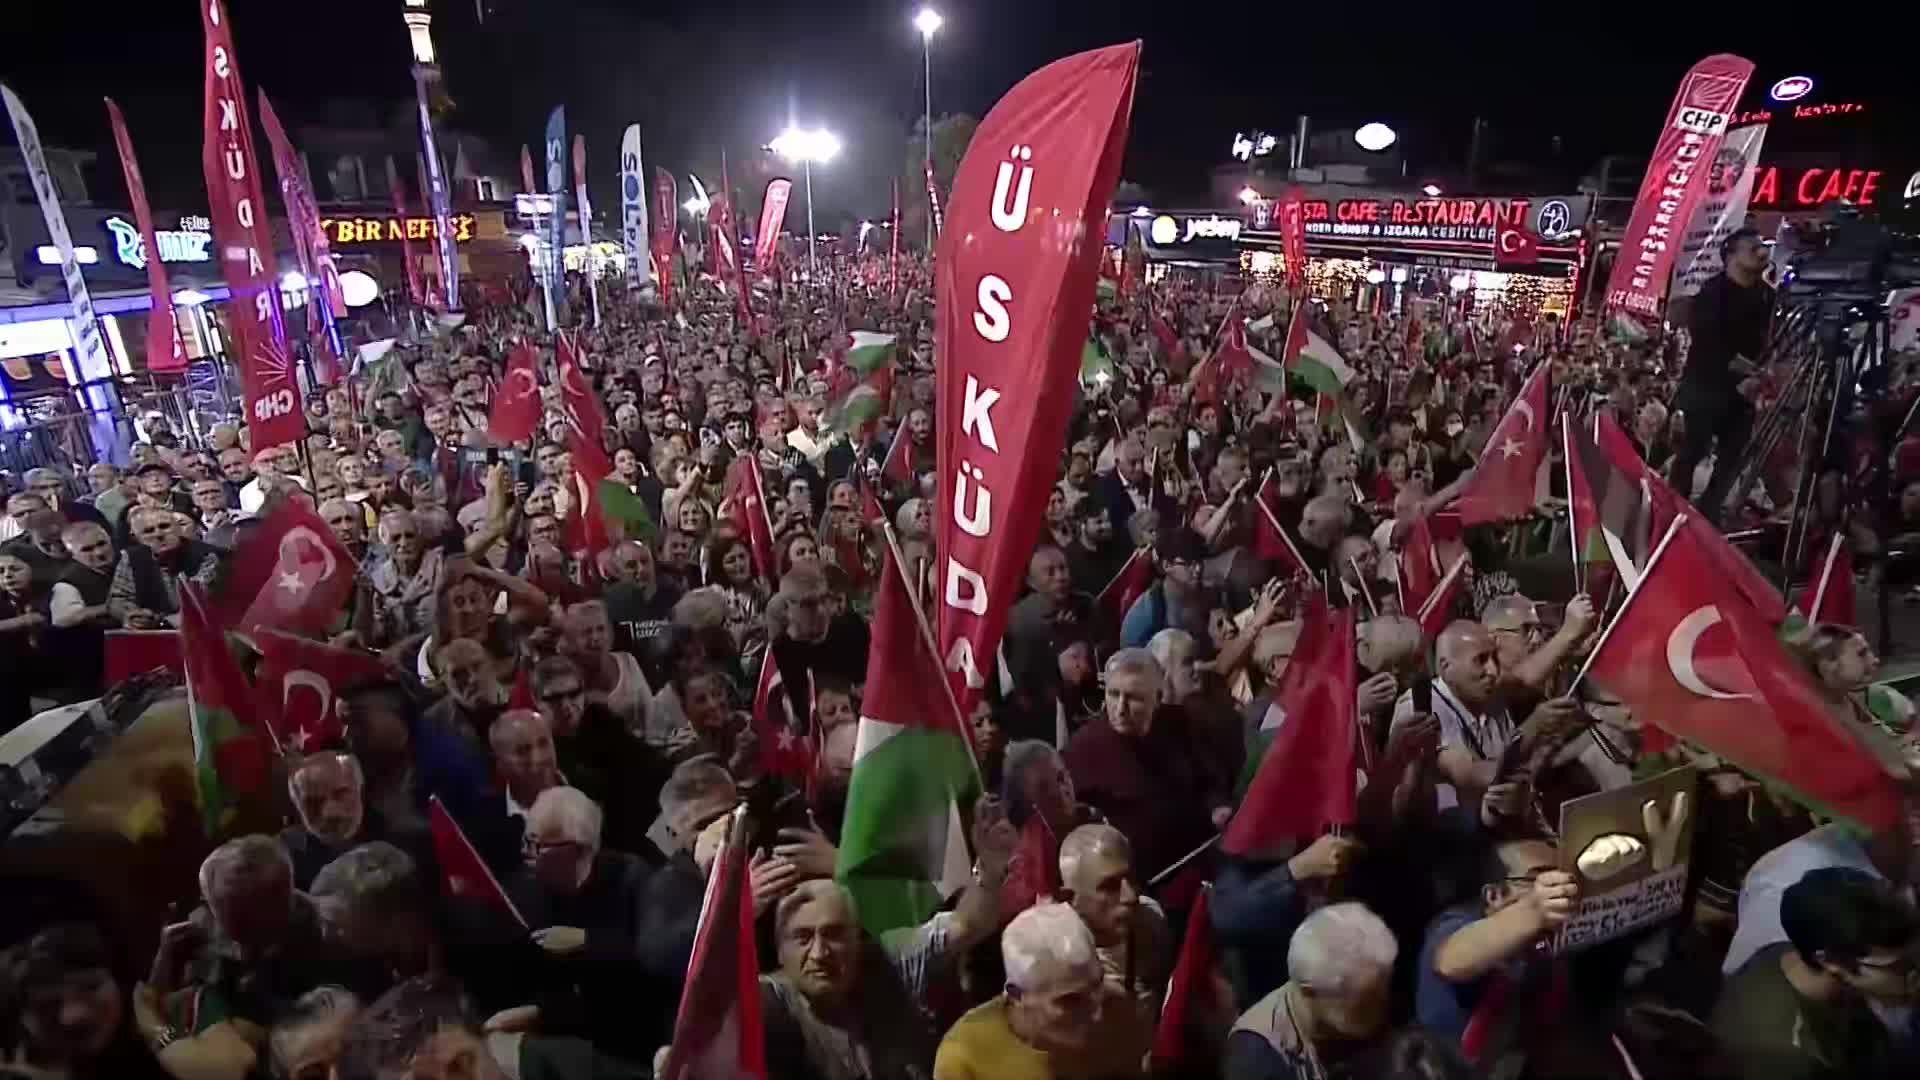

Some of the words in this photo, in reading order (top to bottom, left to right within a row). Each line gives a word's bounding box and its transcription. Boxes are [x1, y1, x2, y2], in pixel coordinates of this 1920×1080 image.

[1682, 110, 1723, 130] CHP
[1797, 167, 1882, 206] CAFE
[1337, 201, 1379, 221] CAFE
[388, 218, 458, 241] NEFS
